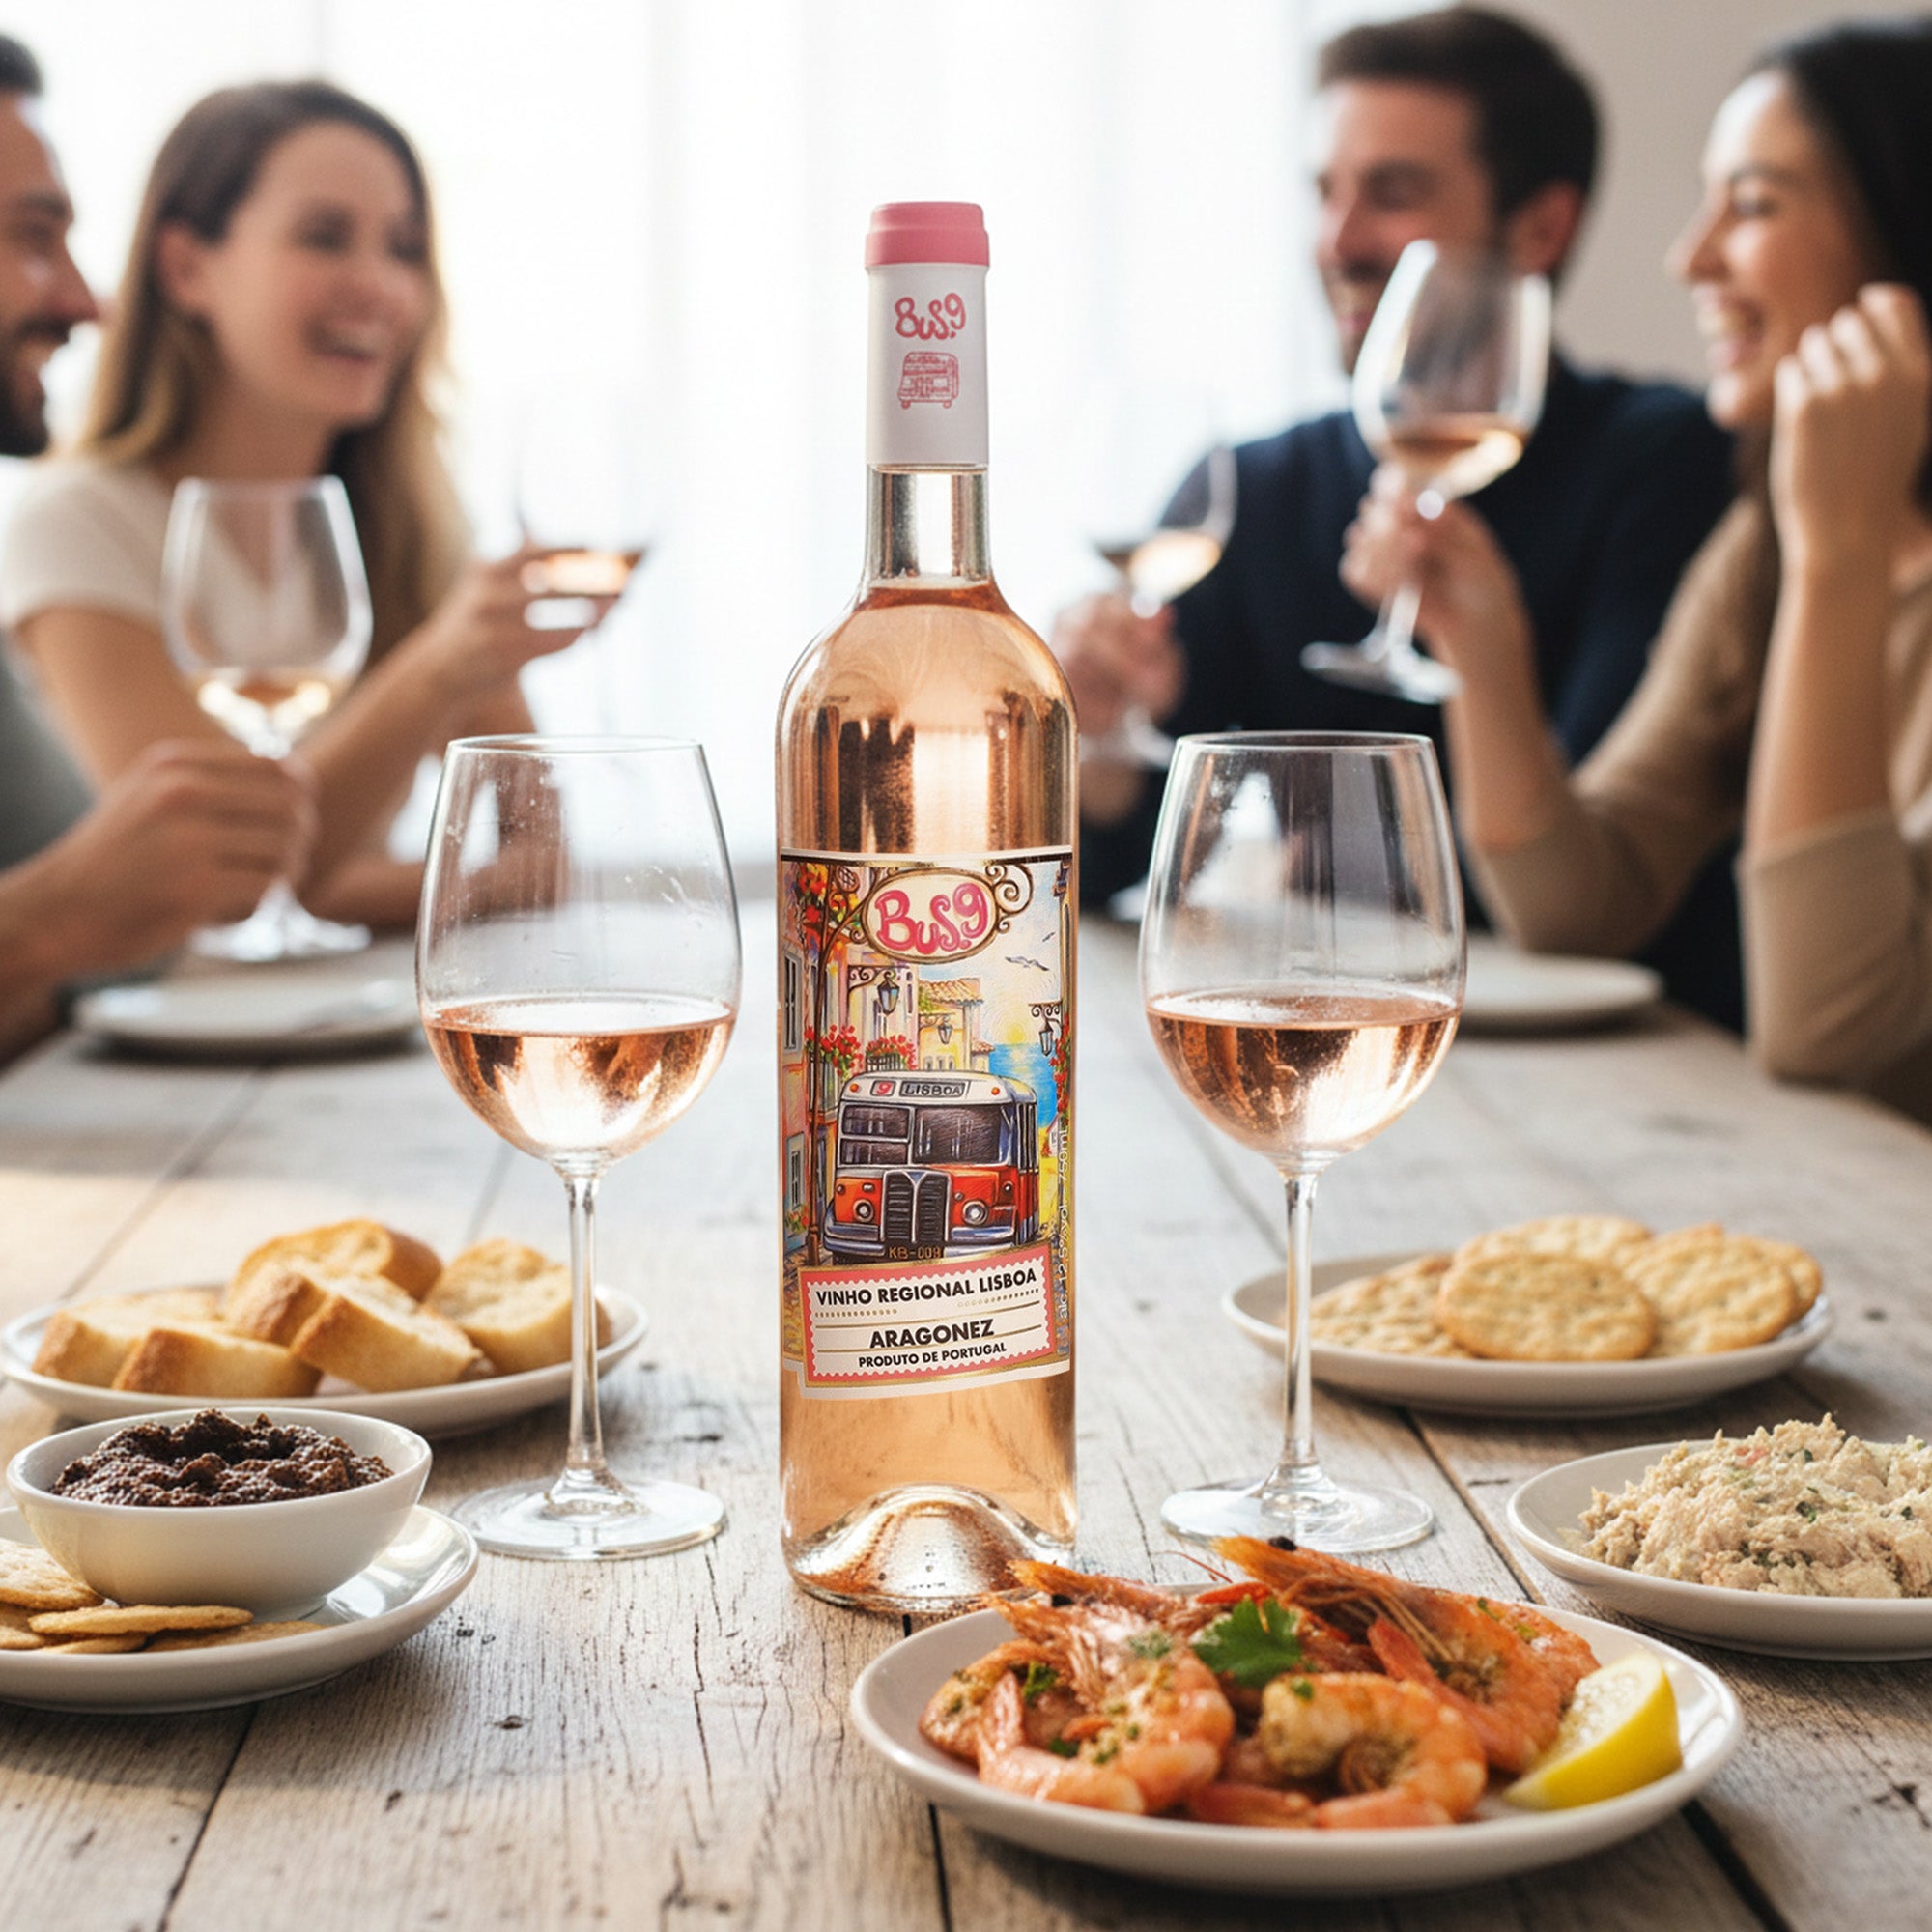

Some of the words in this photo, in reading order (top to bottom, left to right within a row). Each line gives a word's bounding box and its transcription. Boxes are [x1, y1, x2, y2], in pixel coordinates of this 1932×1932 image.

[877, 1080, 893, 1094] 9
[904, 1084, 961, 1095] LISBOA
[816, 1288, 872, 1306] VINHO
[878, 1279, 975, 1304] REGIONAL
[979, 1267, 1037, 1293] LISBOA
[869, 1319, 994, 1349] ARAGONEZ
[858, 1353, 919, 1368] PRODUTO
[923, 1351, 939, 1362] DE
[942, 1342, 1007, 1360] PORTUGAL
